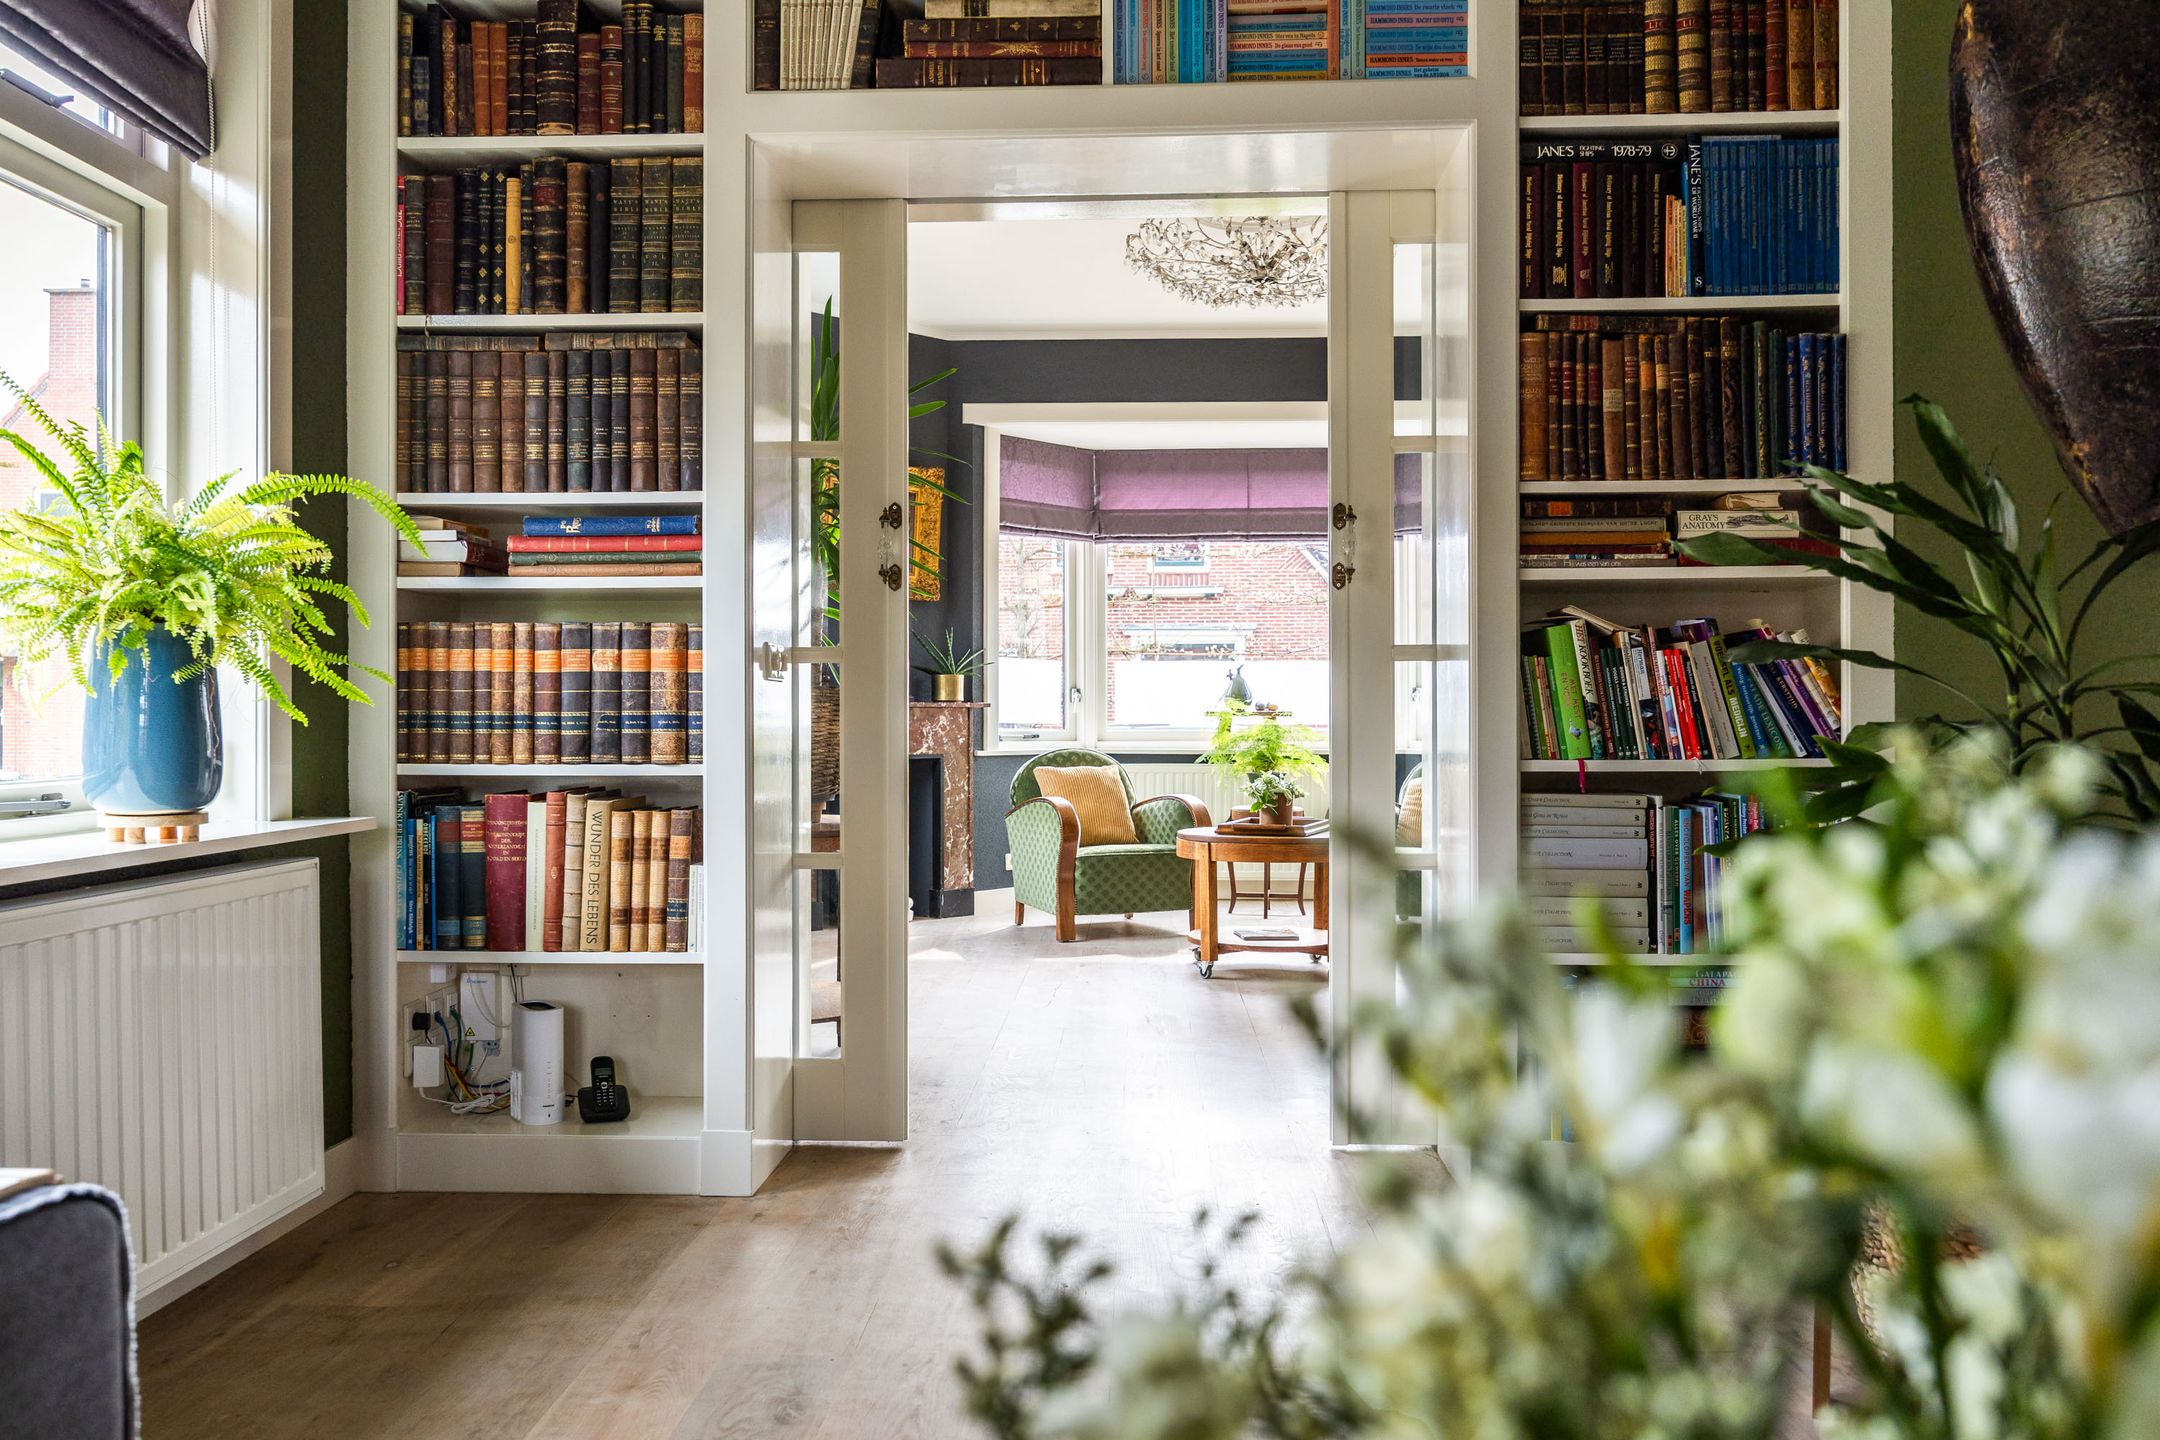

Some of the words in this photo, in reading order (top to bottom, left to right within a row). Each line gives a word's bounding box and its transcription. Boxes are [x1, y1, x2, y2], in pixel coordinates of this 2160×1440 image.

[1537, 145, 1574, 159] JANE'S
[1611, 145, 1652, 157] 1978-79
[1688, 143, 1701, 185] JANE'S
[1691, 187, 1697, 195] OF
[1682, 521, 1725, 530] ANATOMY
[1688, 514, 1719, 522] GRAY'S
[1563, 560, 1575, 568] Hij
[1574, 623, 1586, 645] HET
[1577, 644, 1595, 696] KOOKBOEK
[1636, 648, 1646, 675] Herman
[1713, 639, 1731, 678] VOESEL
[1724, 678, 1736, 696] ALS
[1740, 684, 1756, 716] natuurlijk
[1728, 696, 1749, 739] MEDICIJN
[1761, 711, 1784, 751] LEXICON
[588, 810, 603, 868] WUNDER
[1683, 817, 1691, 873] ENCYCLOPEDIE
[587, 872, 600, 896] DES
[1683, 889, 1691, 925] WAPENS
[585, 900, 598, 945] LEBENS
[1689, 978, 1726, 987] CHINA
